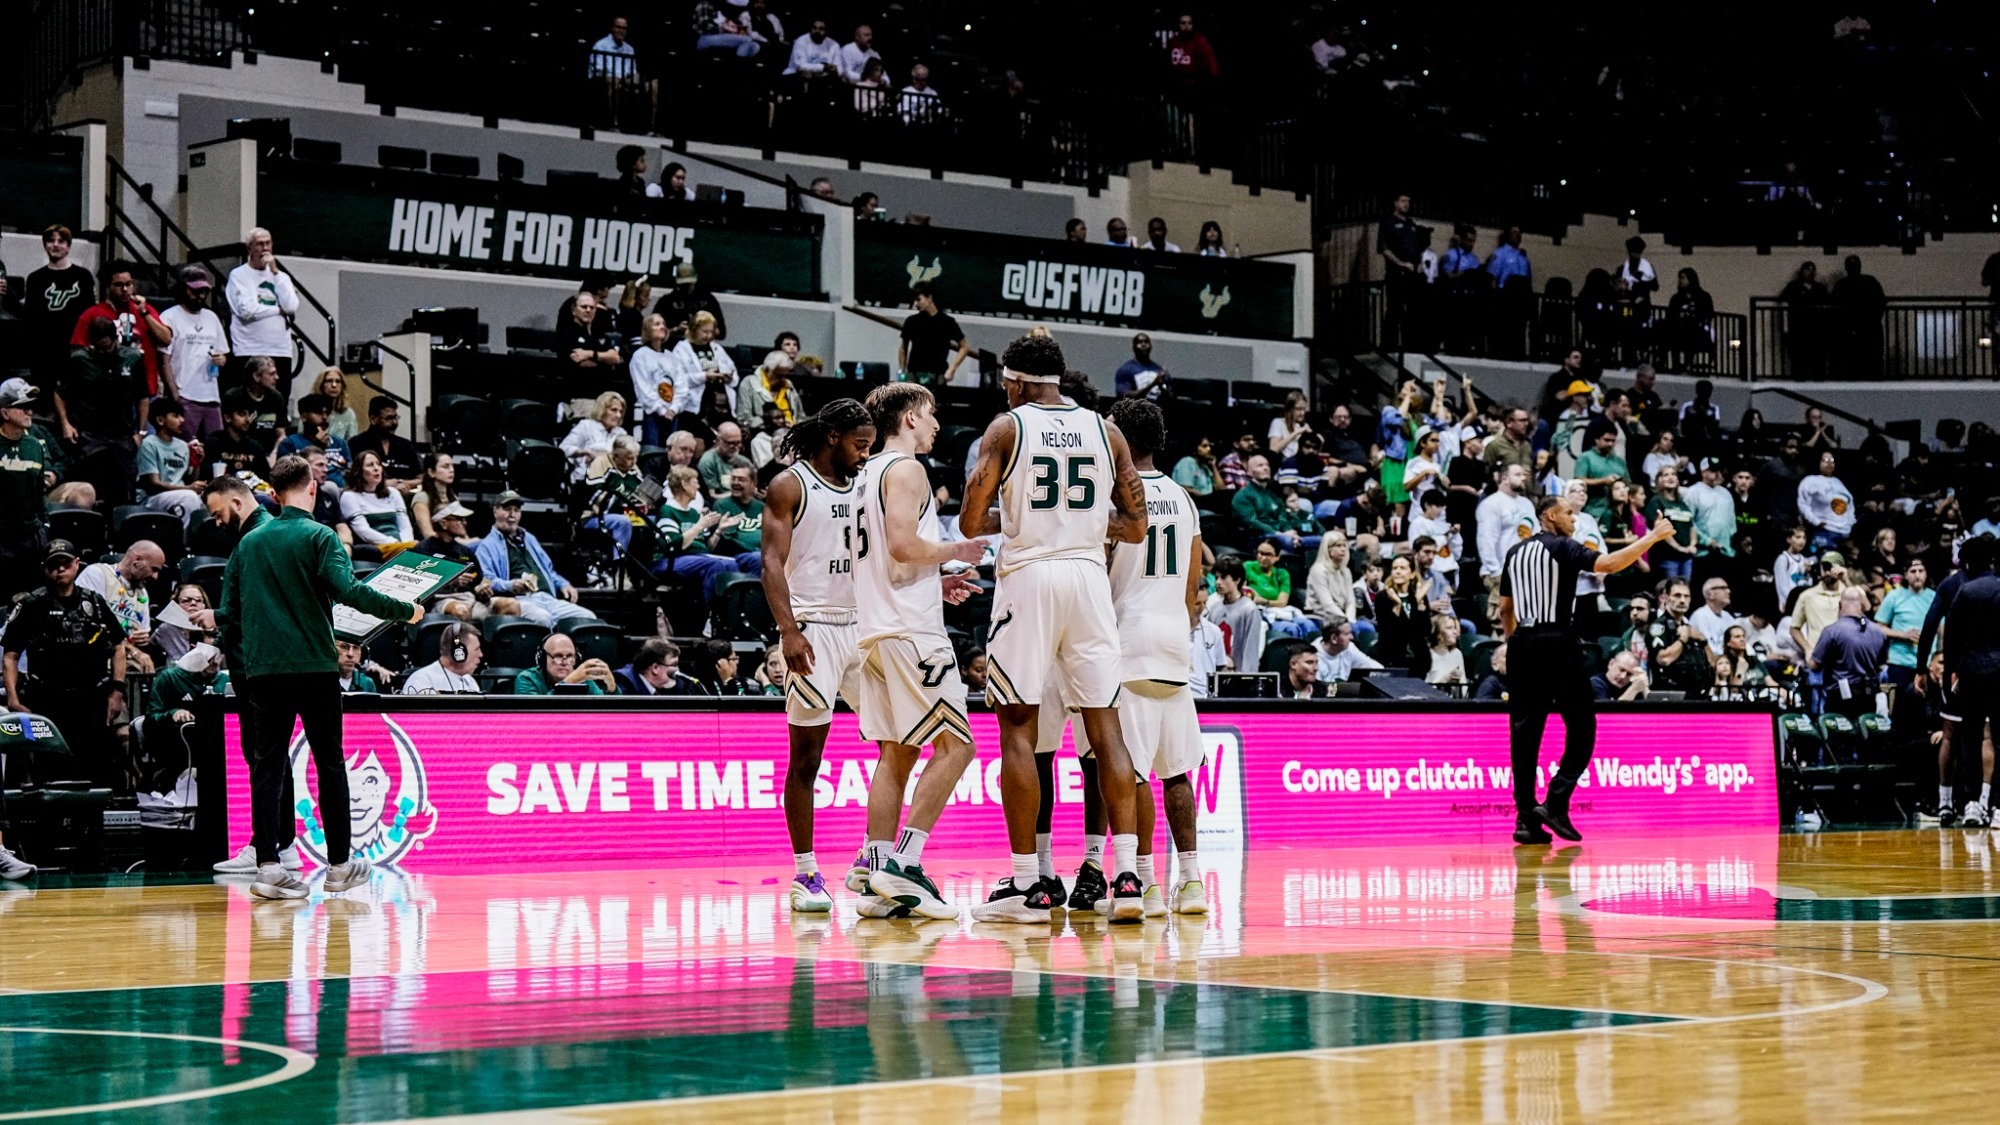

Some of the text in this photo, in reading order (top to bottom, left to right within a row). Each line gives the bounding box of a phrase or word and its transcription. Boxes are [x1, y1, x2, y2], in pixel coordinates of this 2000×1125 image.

[389, 198, 695, 276] HOME FOR HOOPS
[1002, 260, 1145, 317] @USFWBB
[1041, 431, 1082, 448] NELSON
[1027, 454, 1099, 512] 35
[831, 503, 850, 518] SOU
[1147, 500, 1173, 516] ROWN
[1141, 522, 1181, 579] 11
[1, 723, 22, 732] TGH
[486, 761, 631, 815] SAVE
[1282, 760, 1361, 792] Come
[1366, 767, 1400, 799] up
[1405, 758, 1484, 791] clutch
[1548, 760, 1590, 788] te
[1705, 762, 1754, 792] app.
[1451, 803, 1492, 815] Account
